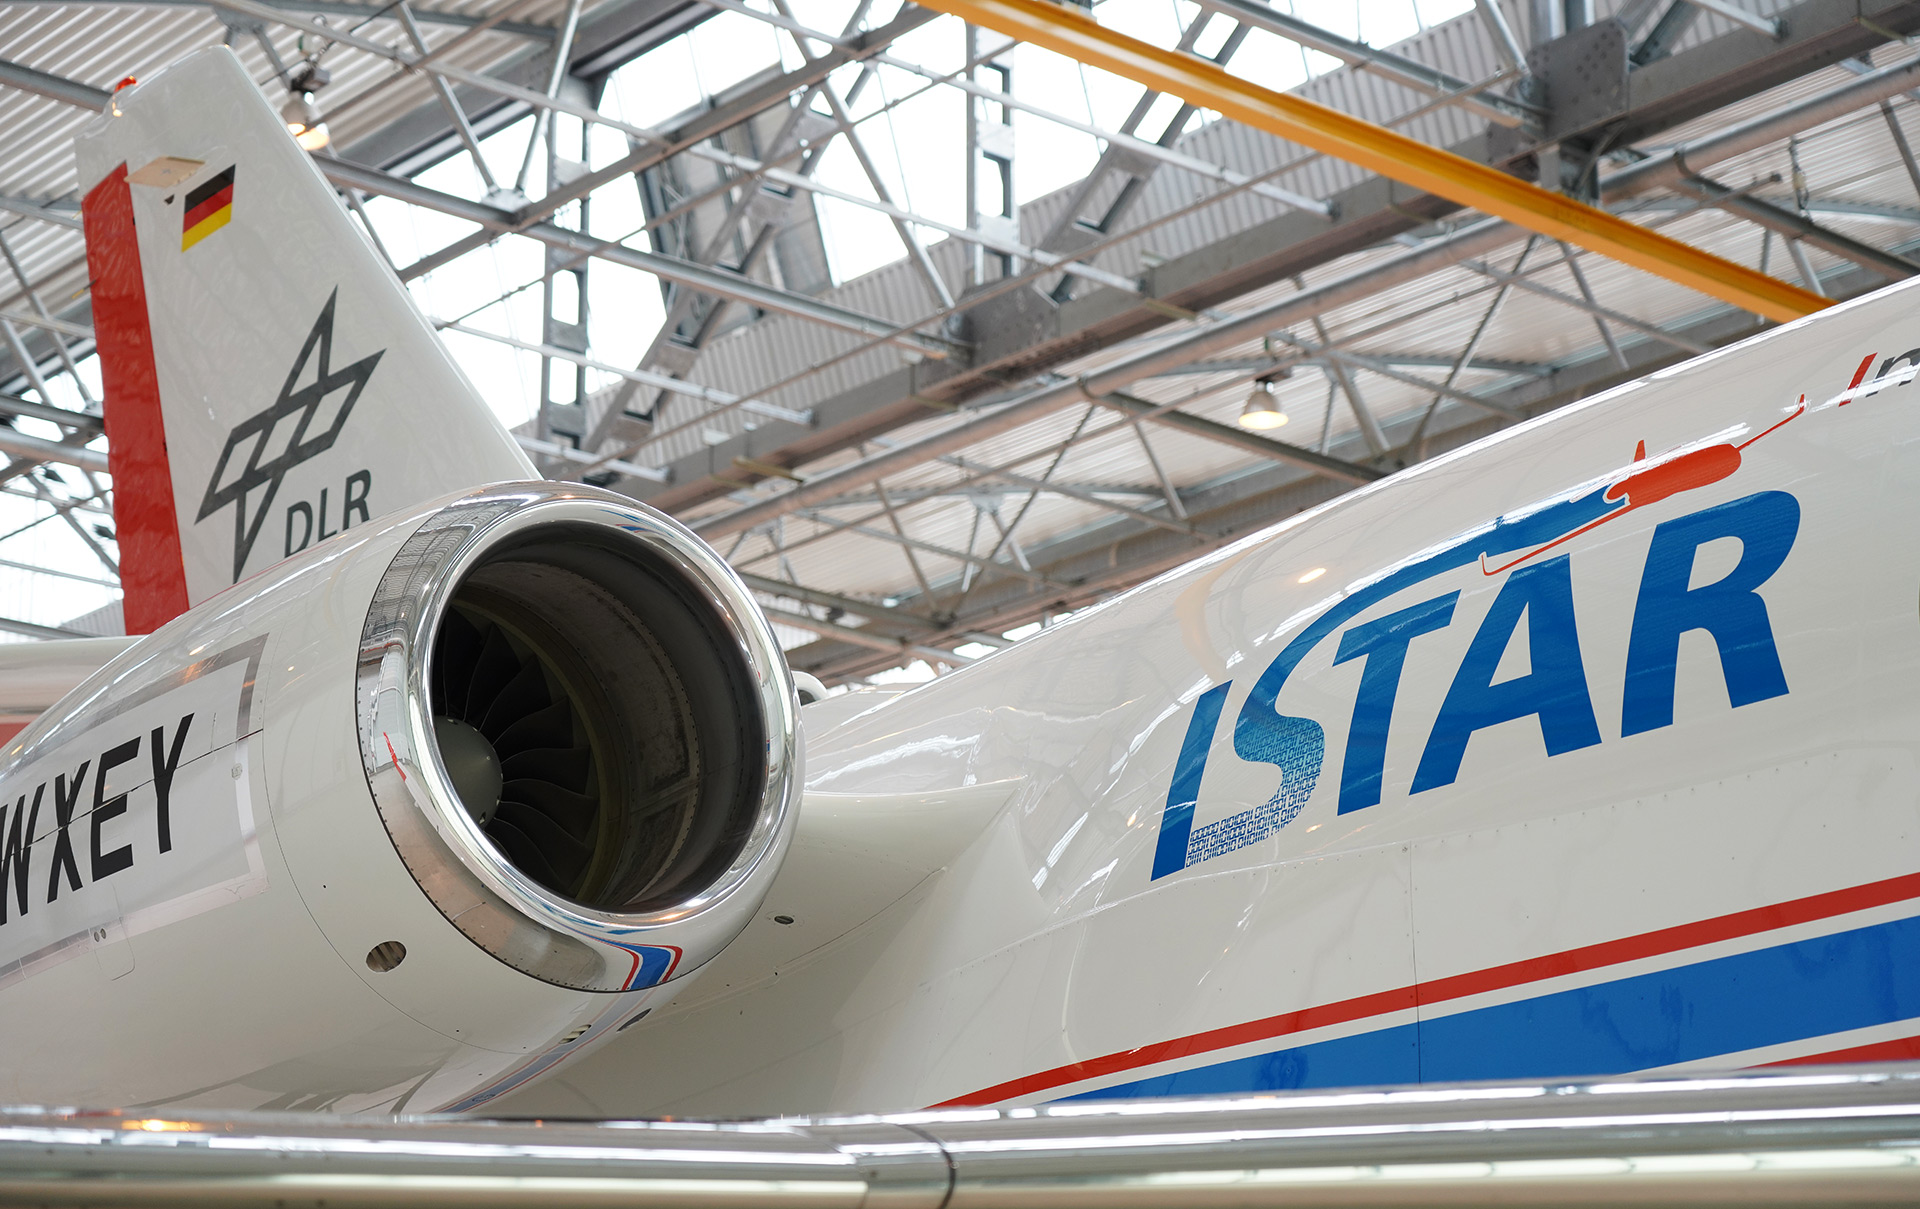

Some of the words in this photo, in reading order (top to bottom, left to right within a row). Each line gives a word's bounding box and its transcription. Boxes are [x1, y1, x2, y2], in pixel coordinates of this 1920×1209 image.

[284, 469, 371, 558] DLR
[1150, 488, 1801, 882] ISTAR
[0, 713, 195, 926] WXEY
